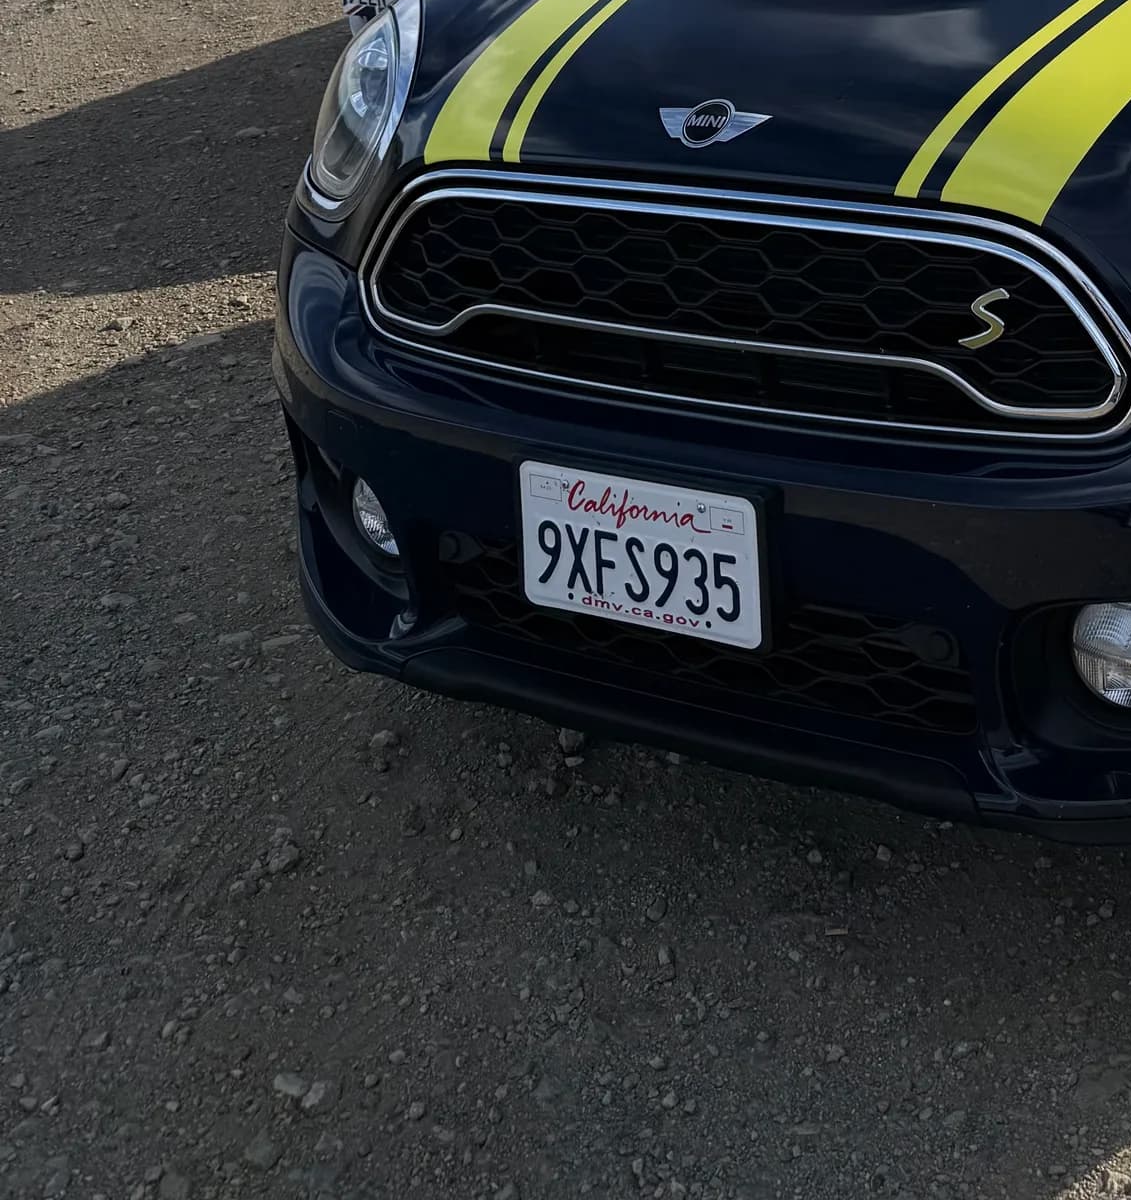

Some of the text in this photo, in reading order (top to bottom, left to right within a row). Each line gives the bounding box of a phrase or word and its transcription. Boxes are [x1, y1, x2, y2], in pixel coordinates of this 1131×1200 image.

[687, 114, 727, 128] MINI
[958, 287, 1010, 350] S
[567, 479, 712, 533] California
[537, 519, 741, 623] 9XFS935
[581, 595, 700, 628] dmv.ca.gov
